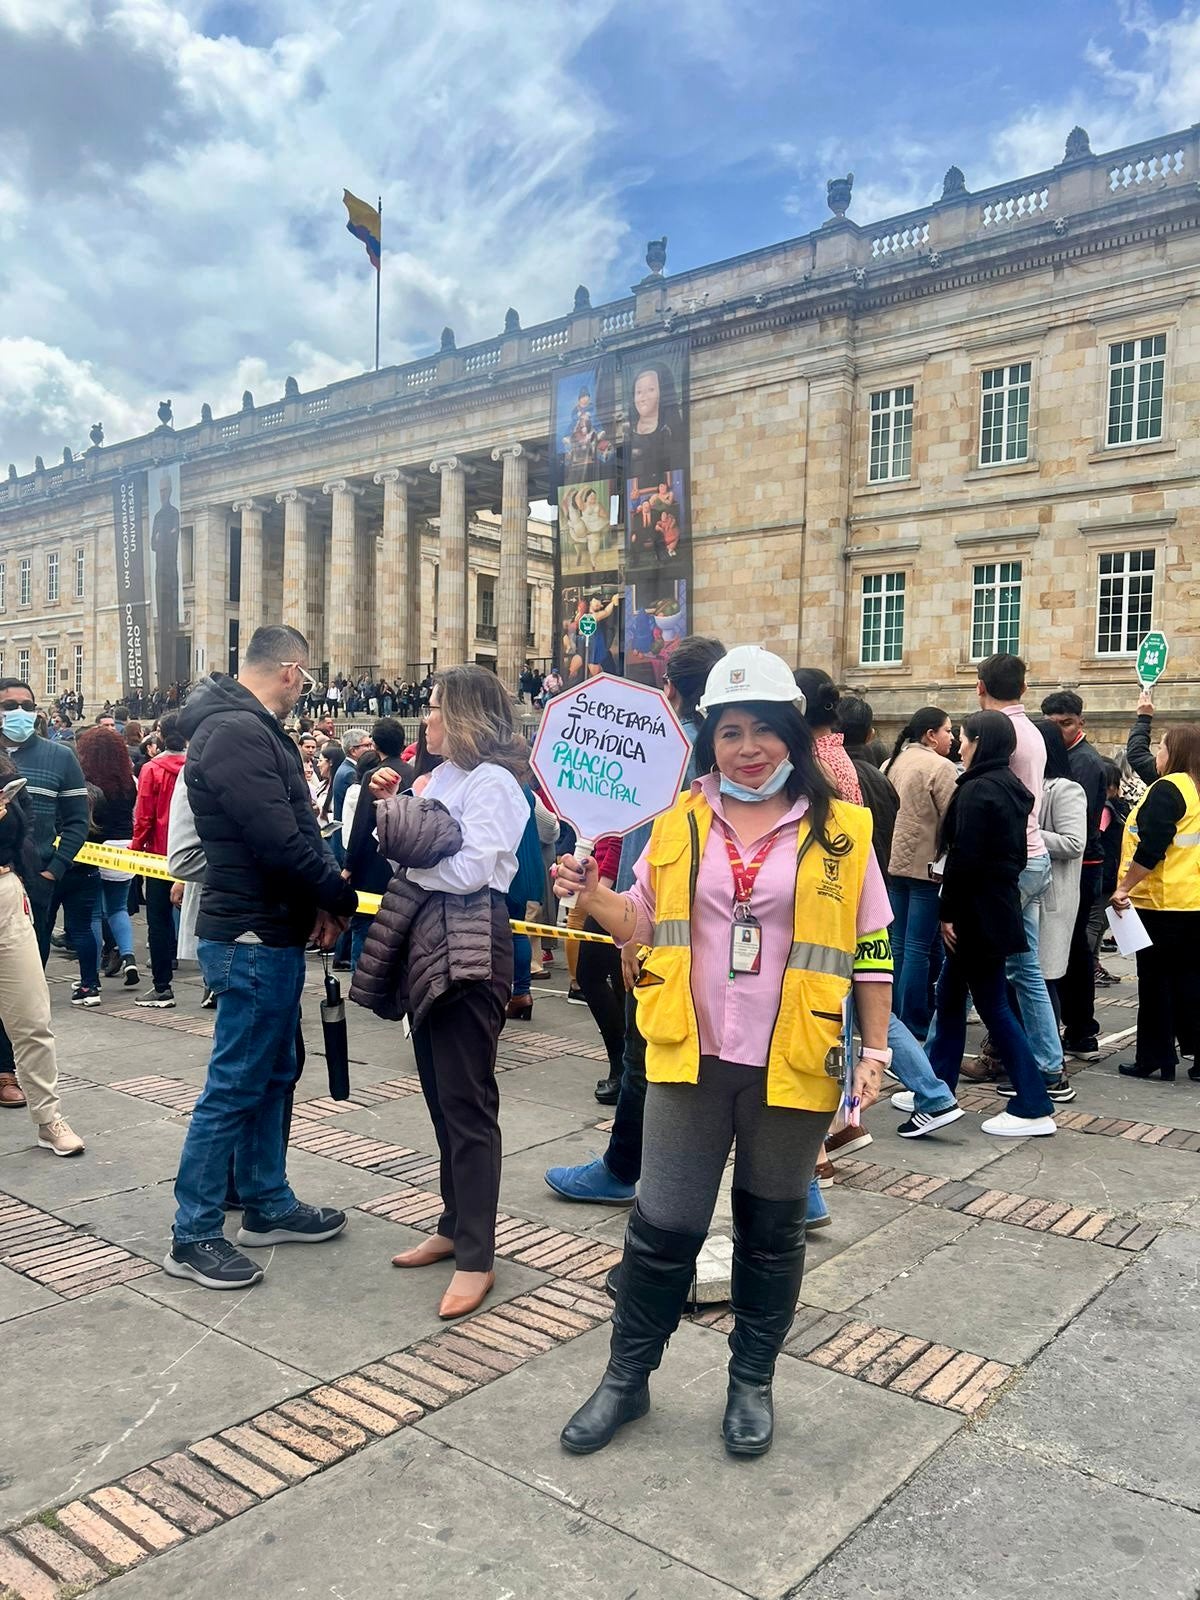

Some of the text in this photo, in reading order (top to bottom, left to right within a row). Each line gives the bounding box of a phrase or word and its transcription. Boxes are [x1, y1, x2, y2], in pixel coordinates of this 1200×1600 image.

[121, 484, 131, 589] UN COLOMBIANO
[128, 482, 137, 552] UNIVERSAL
[126, 603, 136, 687] FERNANDO
[133, 625, 143, 687] BOTERO
[560, 713, 646, 763] JURÍDICA
[570, 693, 667, 737] SECRETARÍA
[552, 741, 623, 781] PALACIO
[557, 768, 641, 806] MUNICIPAL
